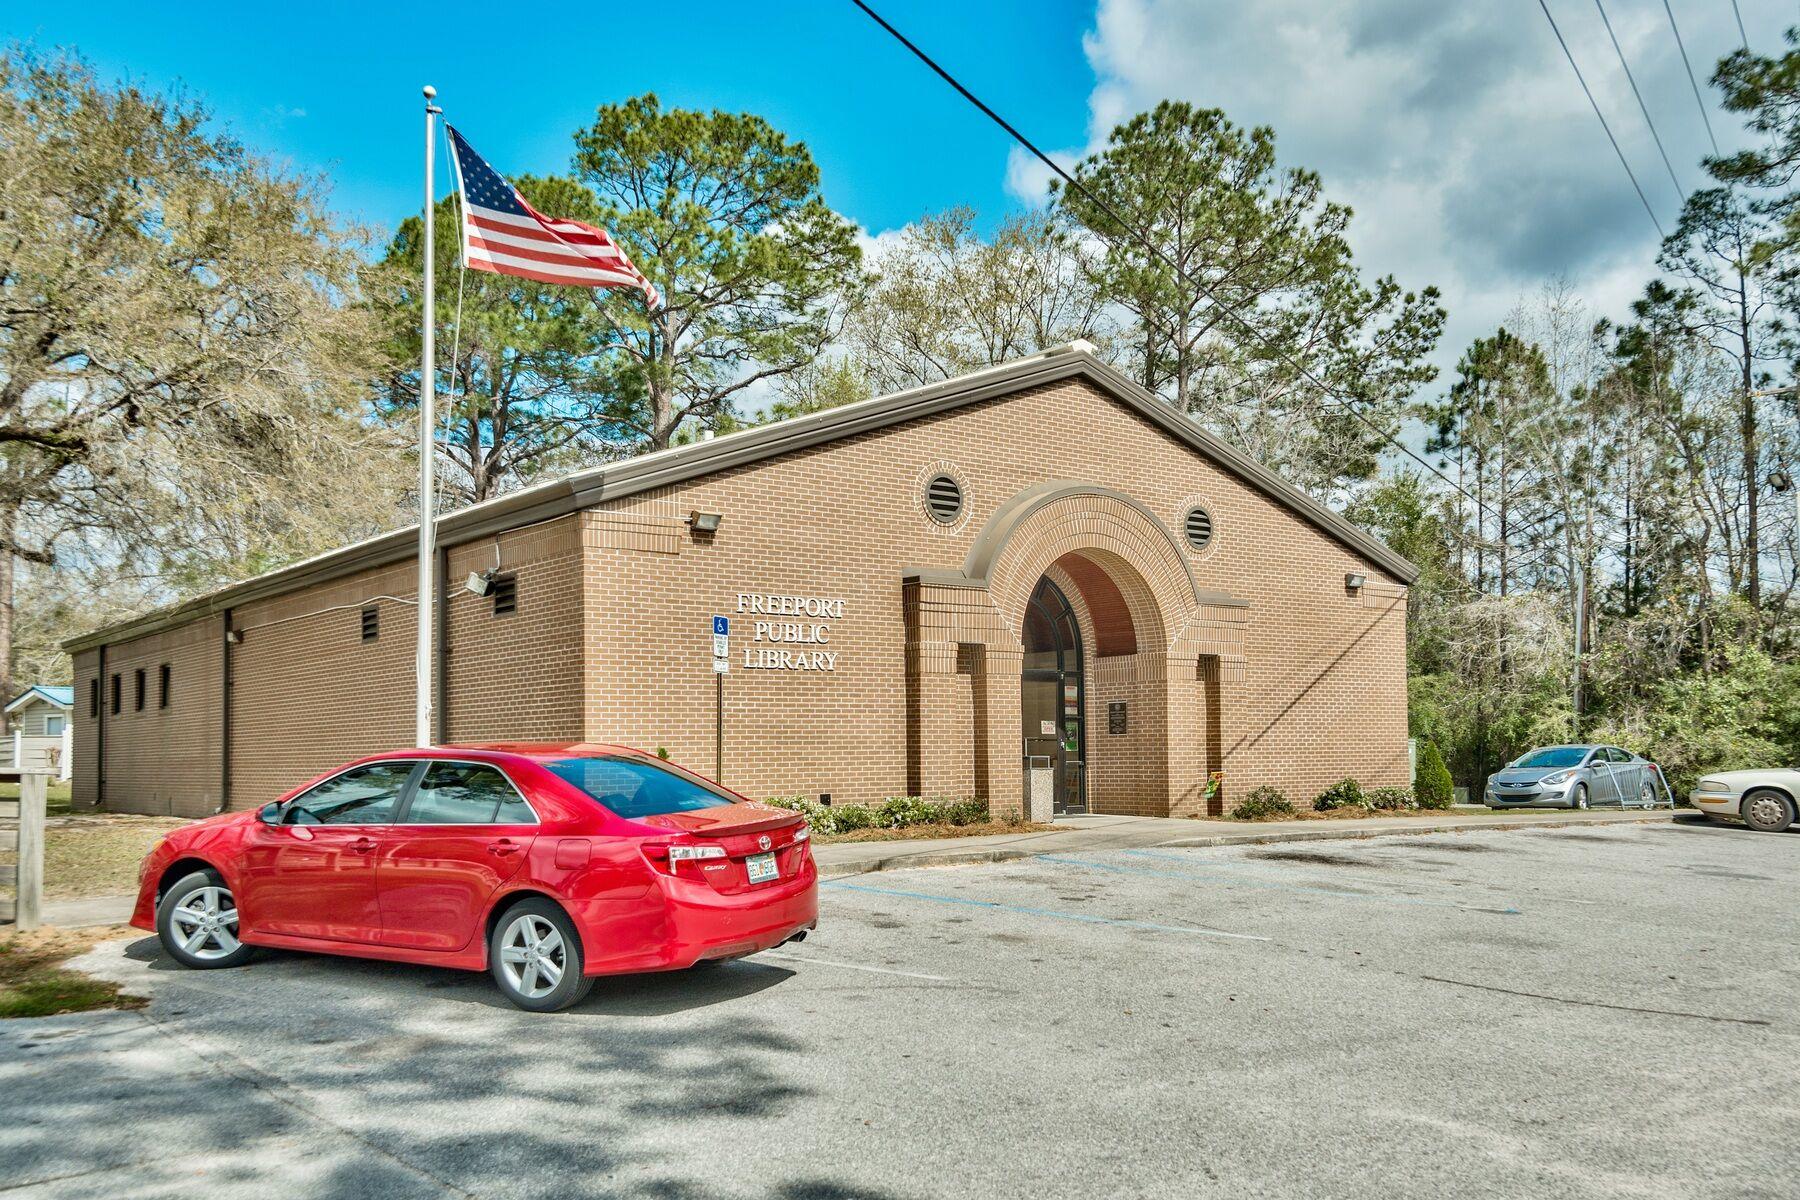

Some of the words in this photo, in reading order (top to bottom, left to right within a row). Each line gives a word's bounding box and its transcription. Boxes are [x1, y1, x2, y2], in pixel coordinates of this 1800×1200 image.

[736, 593, 846, 618] FREEPORT
[754, 621, 830, 645] PUBLIC
[743, 648, 839, 671] LIBRARY
